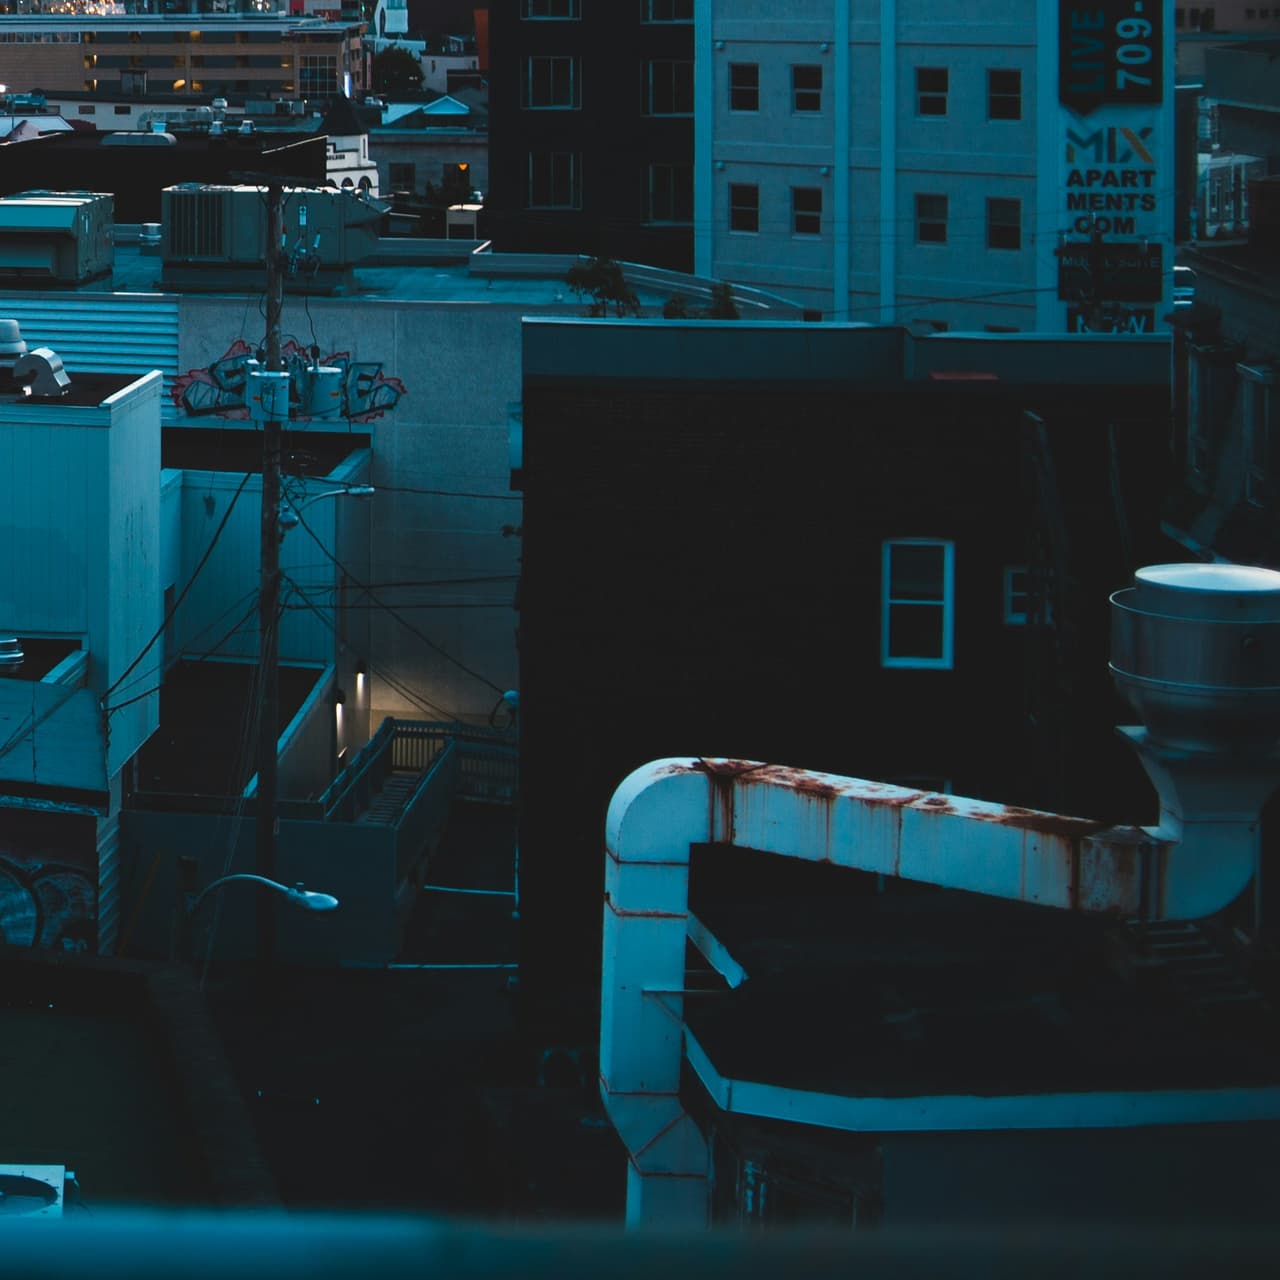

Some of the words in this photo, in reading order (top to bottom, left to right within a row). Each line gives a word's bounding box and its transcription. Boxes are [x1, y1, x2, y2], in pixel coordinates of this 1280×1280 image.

[1070, 10, 1105, 93] LIVE
[1066, 127, 1155, 163] MIX
[1067, 170, 1156, 188] APART
[1067, 193, 1156, 211] MENTS
